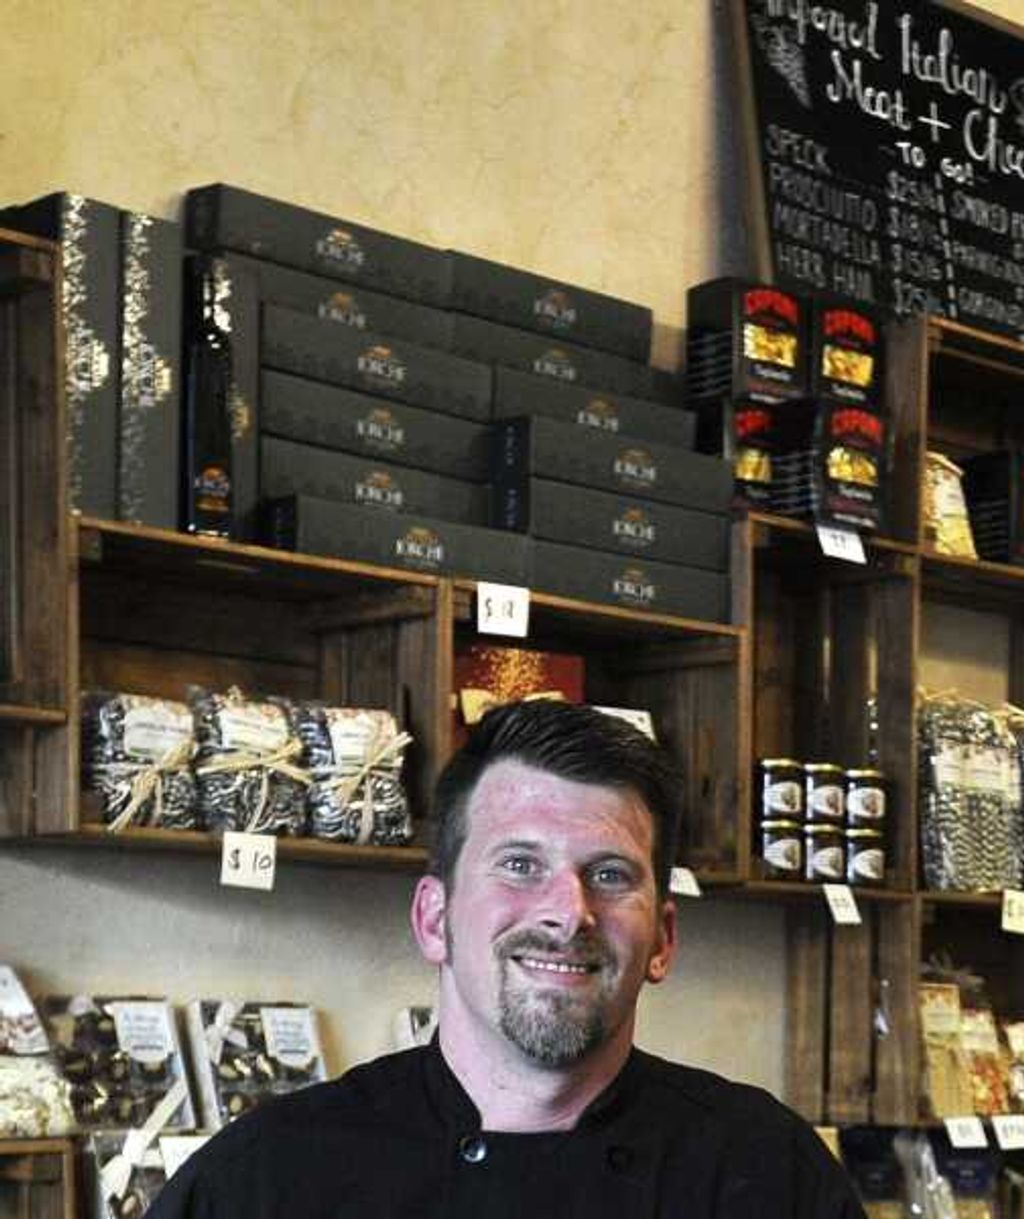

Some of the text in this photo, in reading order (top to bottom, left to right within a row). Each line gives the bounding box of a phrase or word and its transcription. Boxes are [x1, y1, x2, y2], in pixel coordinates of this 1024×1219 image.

[826, 50, 911, 131] Meat
[896, 13, 1007, 114] Italian
[894, 141, 926, 168] TO
[252, 850, 272, 873] 10
